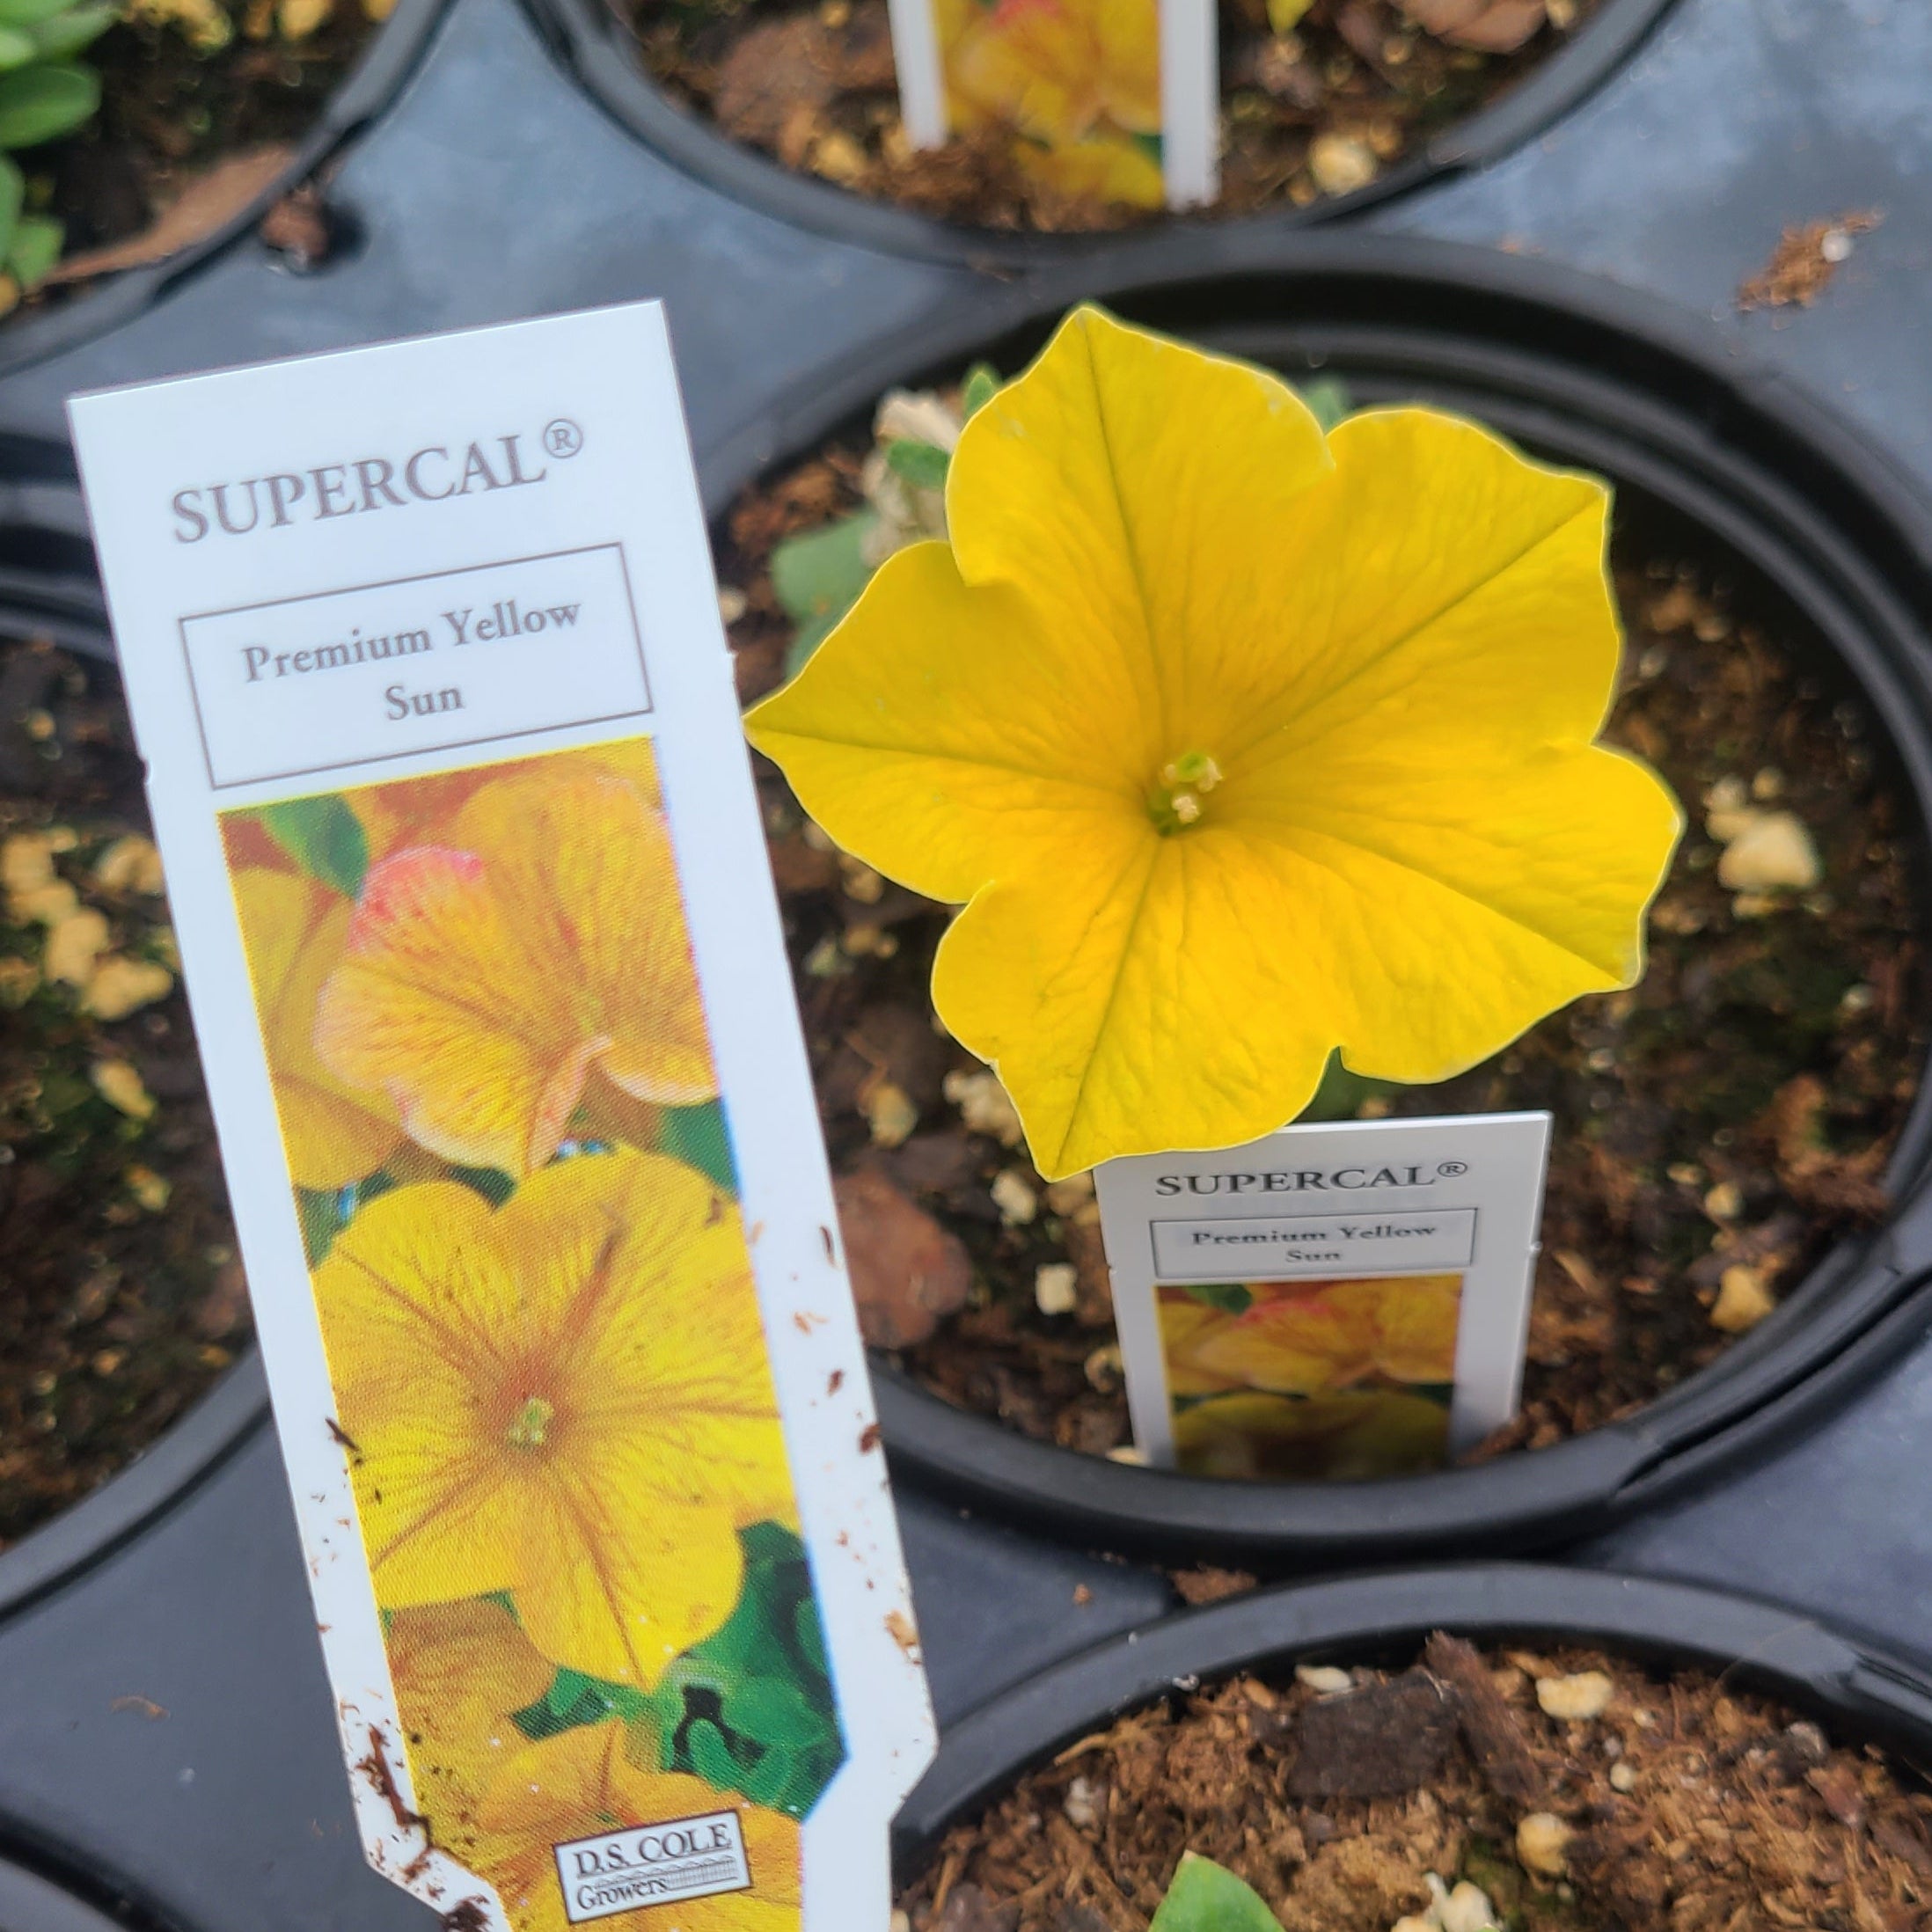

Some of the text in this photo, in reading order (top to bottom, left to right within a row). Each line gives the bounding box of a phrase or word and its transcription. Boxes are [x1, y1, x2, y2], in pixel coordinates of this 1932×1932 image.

[242, 599, 582, 684] Premium Yellow
[384, 684, 465, 721] Sun
[1192, 1223, 1437, 1246] Premium Yellow
[1285, 1249, 1343, 1263] Sun
[573, 1823, 733, 1876] D.S. COLE
[576, 1874, 670, 1911] Growers
